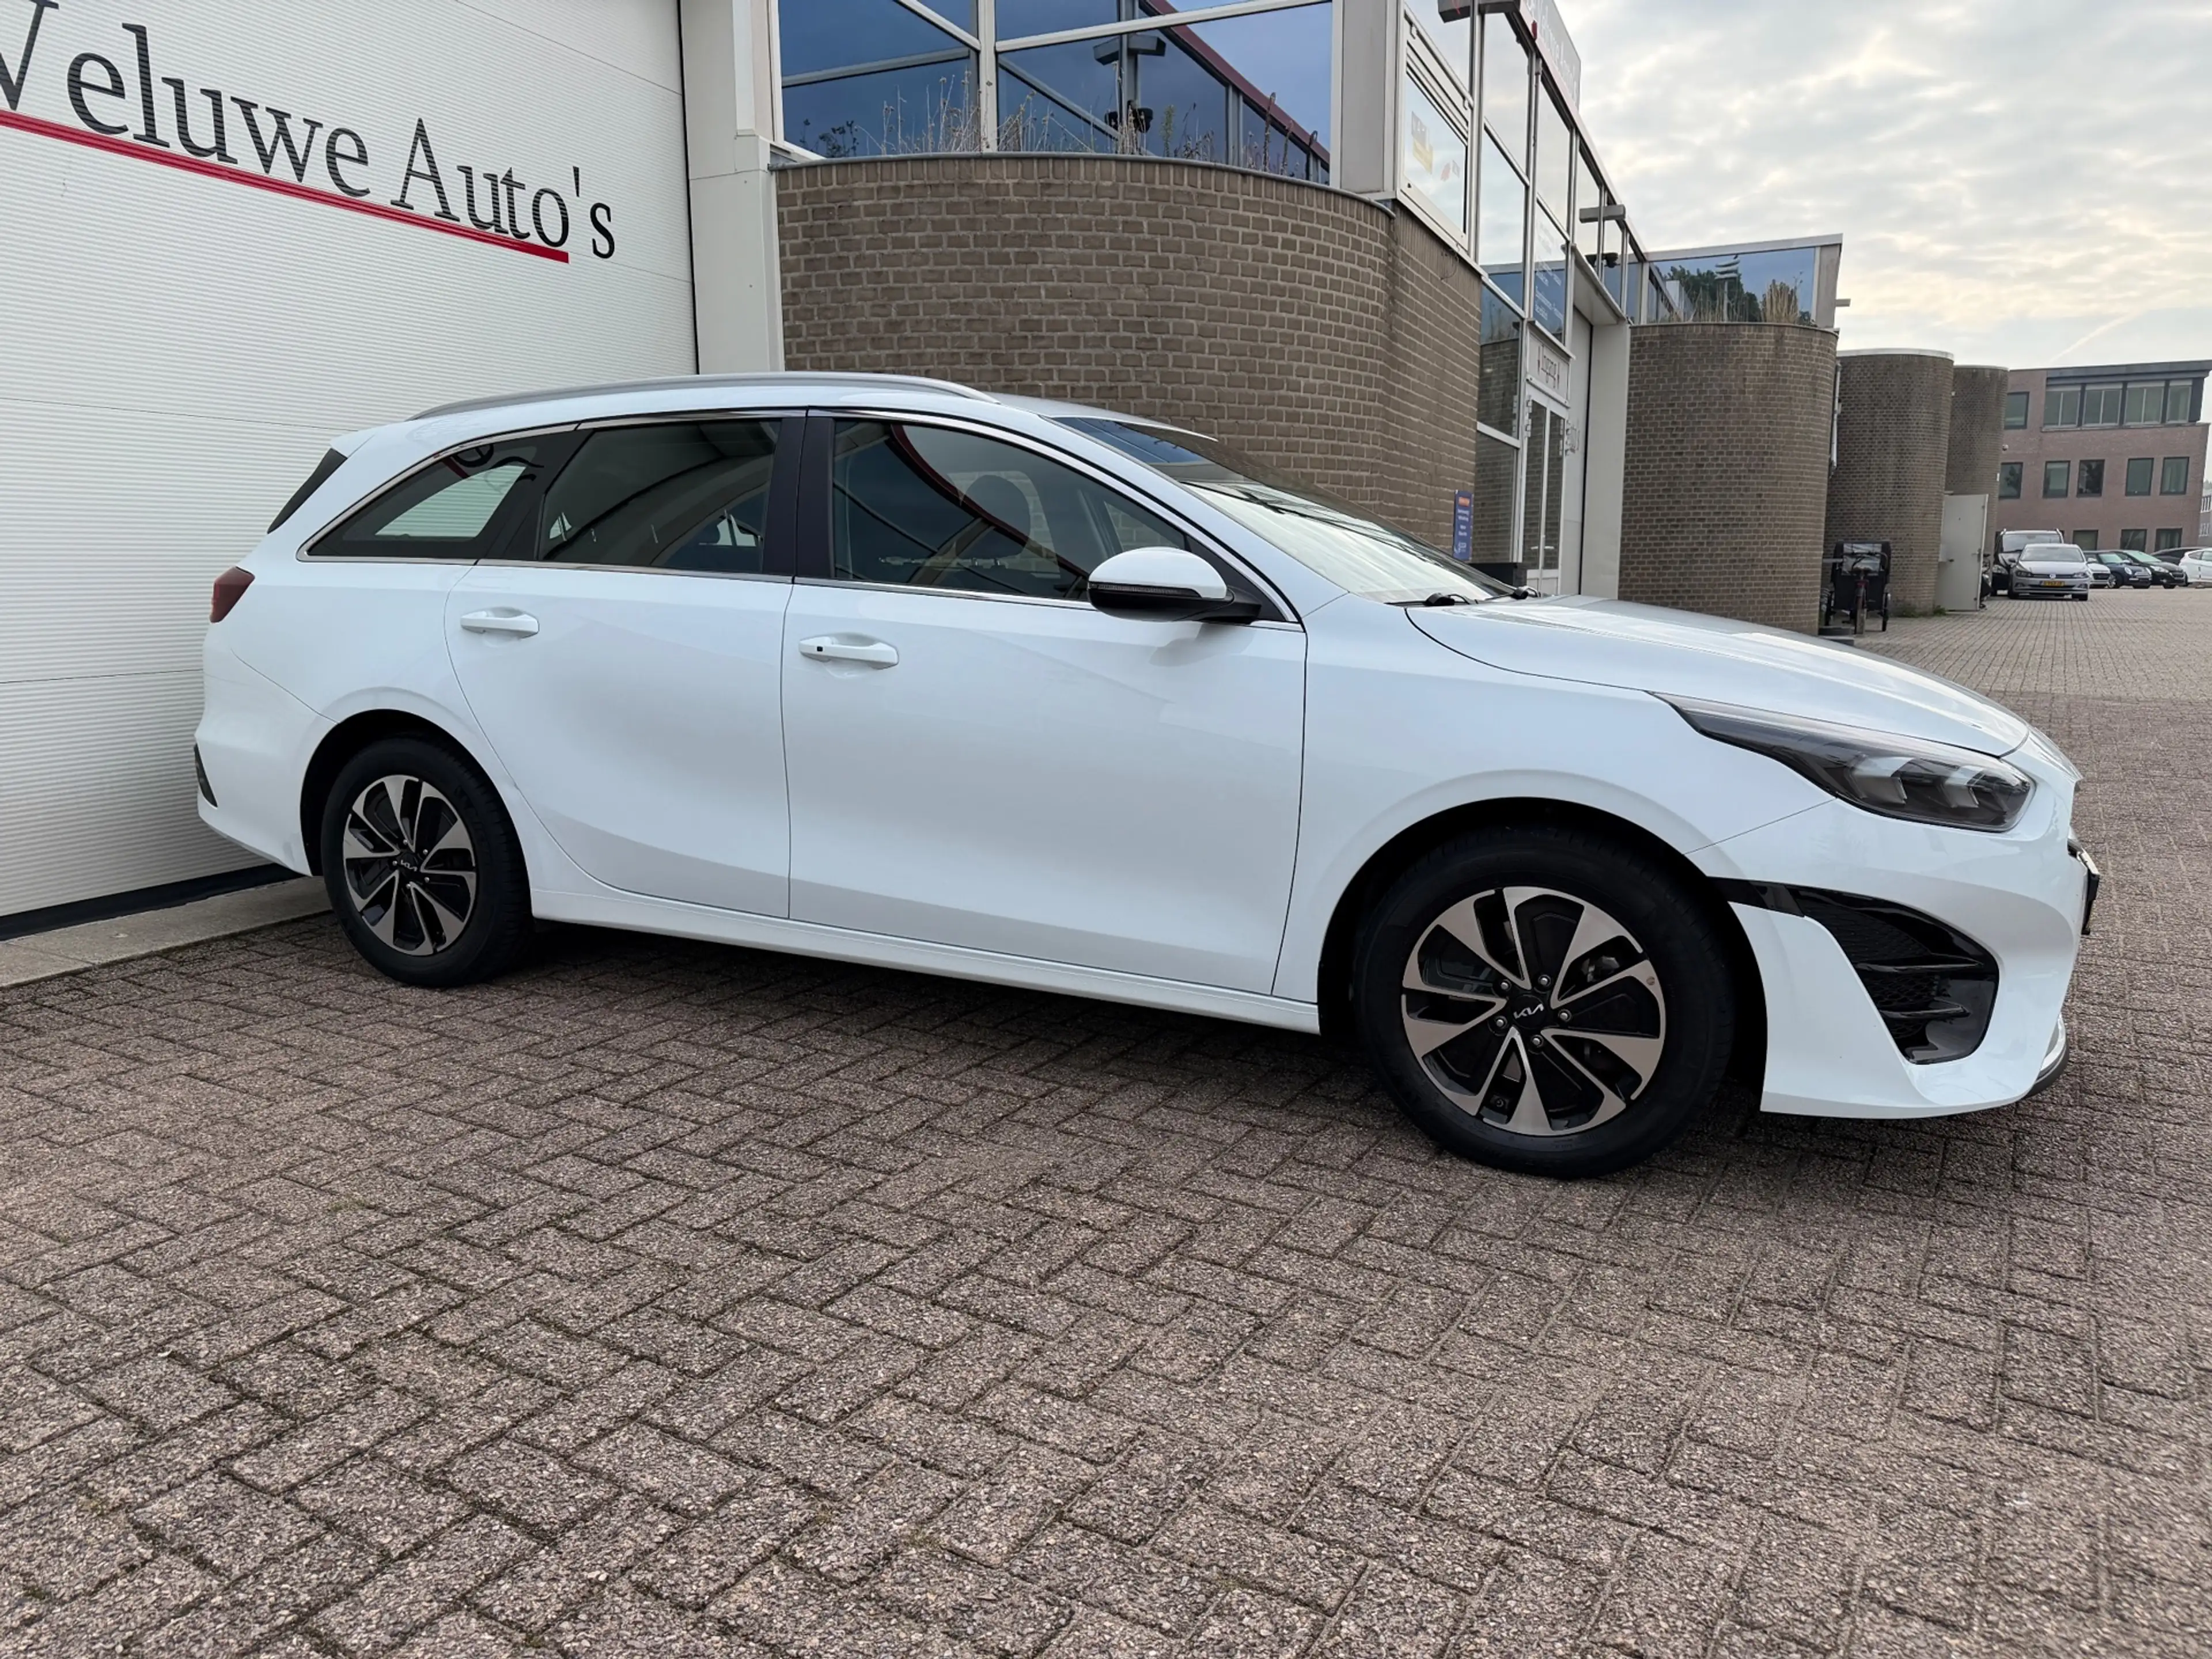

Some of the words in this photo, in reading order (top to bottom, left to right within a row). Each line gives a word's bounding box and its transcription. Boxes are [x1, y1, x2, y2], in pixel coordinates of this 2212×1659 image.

[0, 0, 370, 198] Veluwe
[390, 117, 615, 259] Auto's
[1513, 1003, 1544, 1019] KIA
